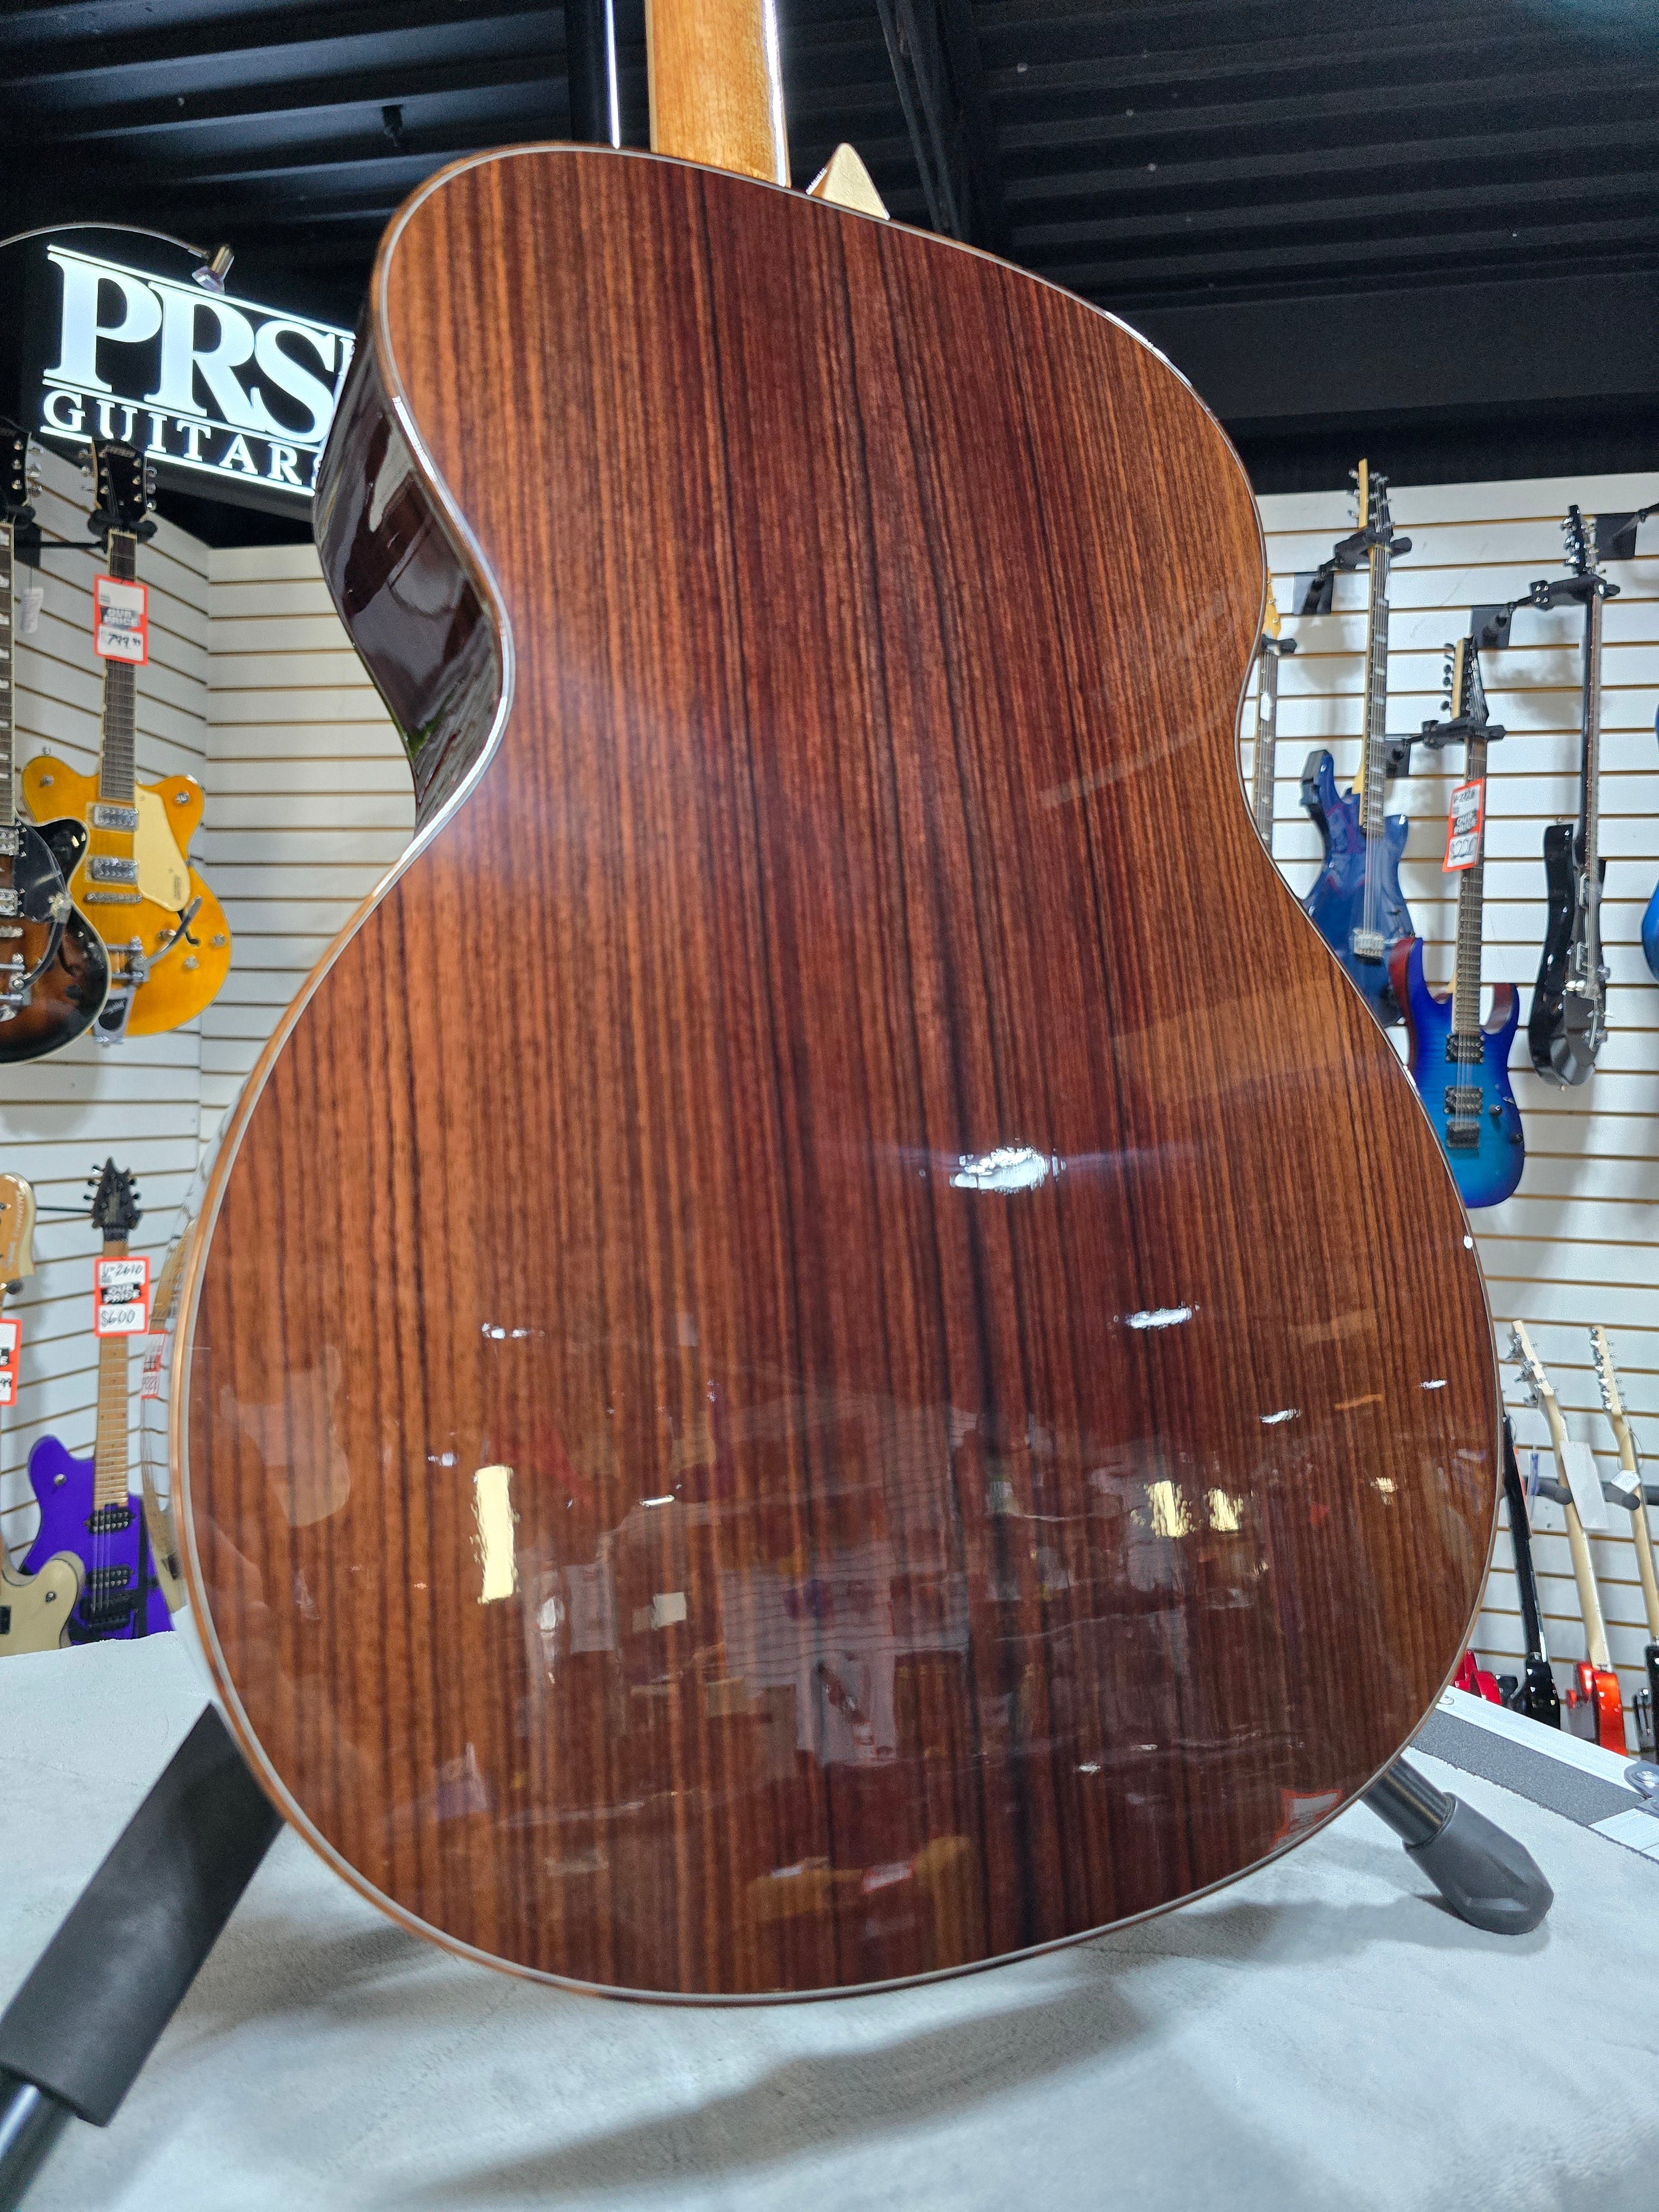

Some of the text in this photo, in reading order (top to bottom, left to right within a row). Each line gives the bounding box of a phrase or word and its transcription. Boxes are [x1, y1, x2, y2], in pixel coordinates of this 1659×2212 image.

[44, 252, 336, 443] PRS
[107, 608, 133, 618] OUR
[103, 615, 139, 627] PRICE
[1457, 812, 1474, 826] OUR
[1454, 817, 1478, 836] PRICE
[103, 1289, 140, 1303] PRICE
[107, 1285, 133, 1295] OUR
